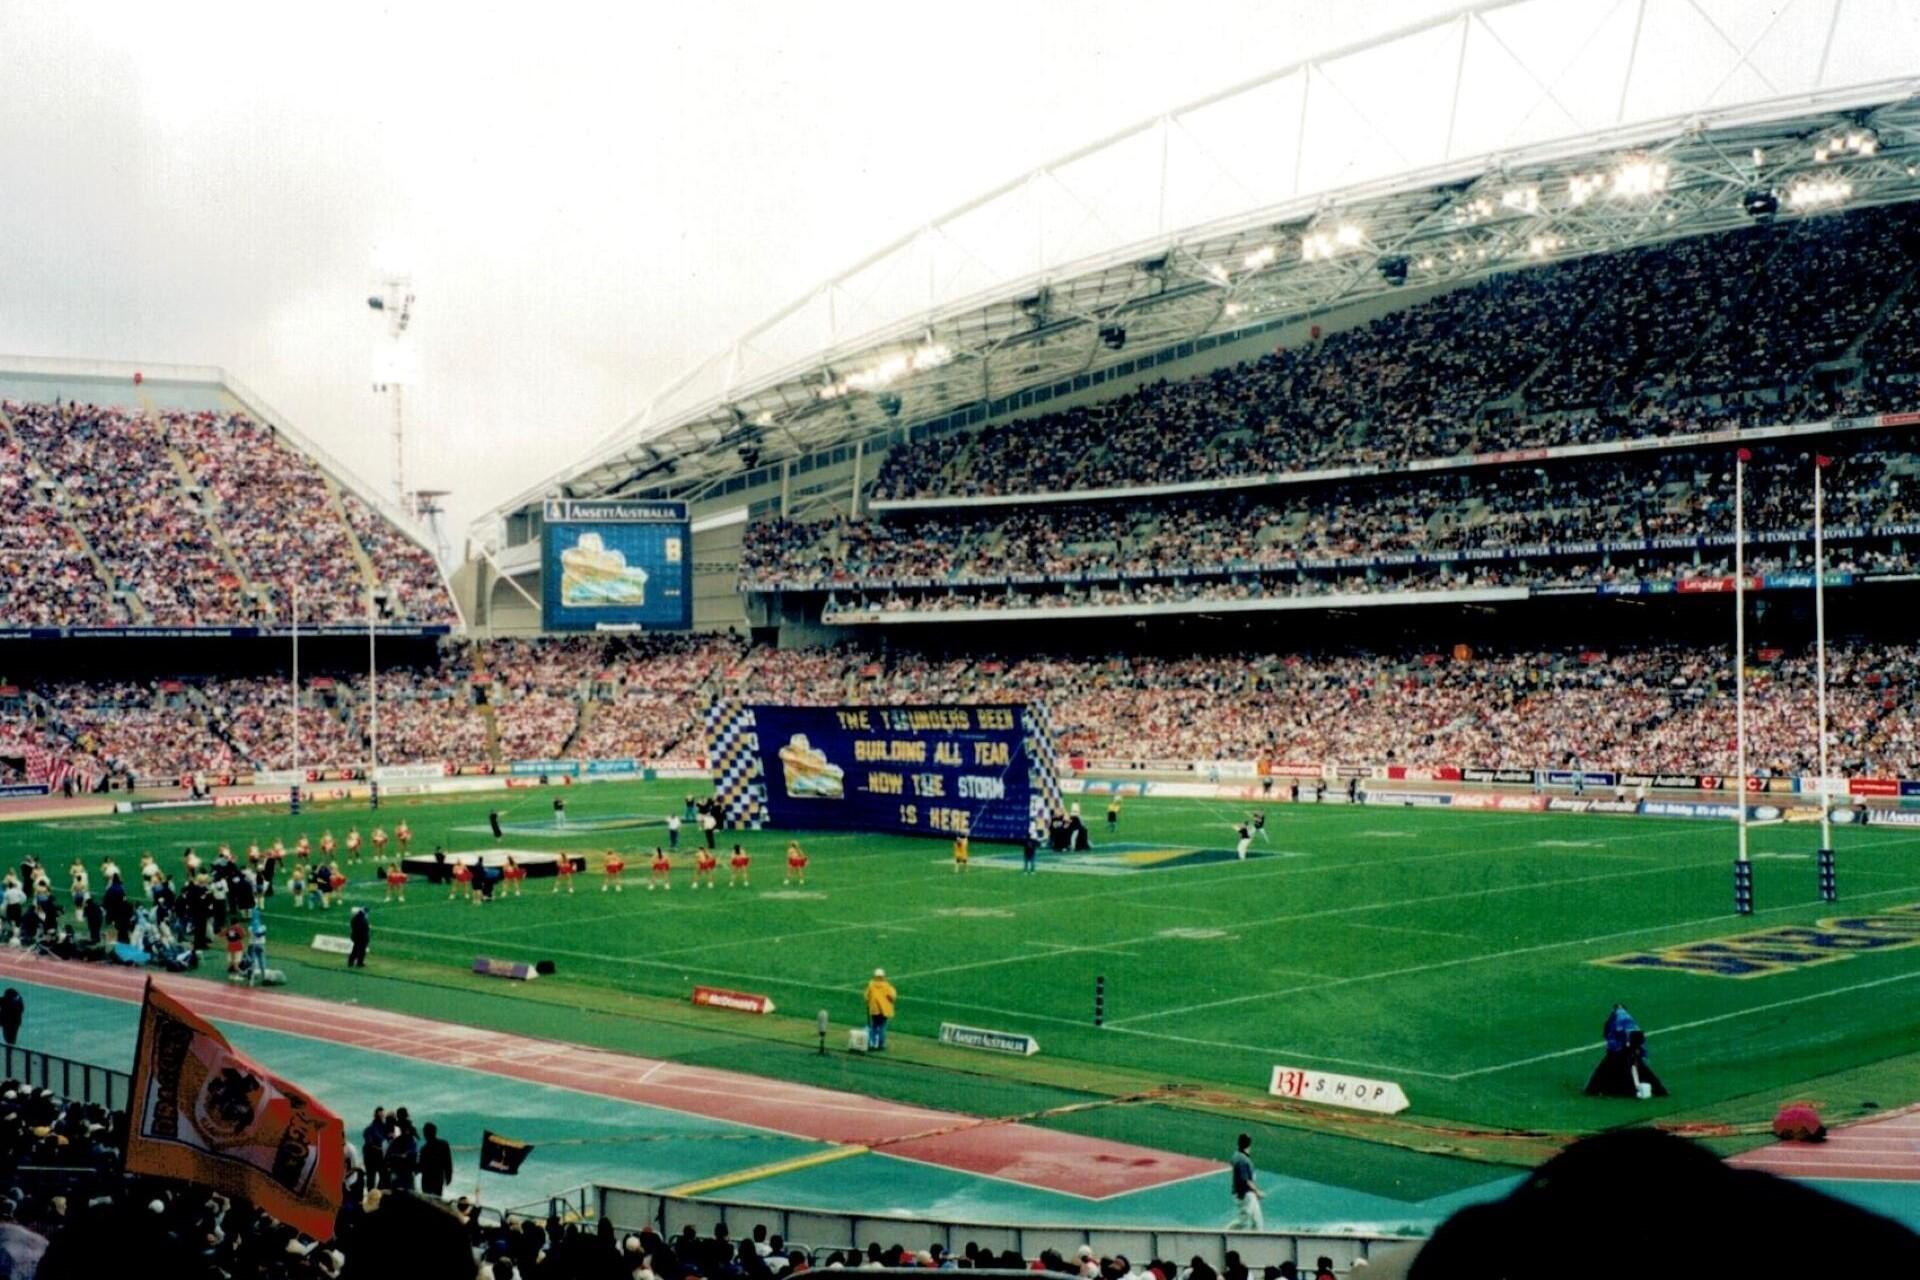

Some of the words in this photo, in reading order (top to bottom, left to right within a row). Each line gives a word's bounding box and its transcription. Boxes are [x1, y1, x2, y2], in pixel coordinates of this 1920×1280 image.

[1611, 540, 1647, 552] TOWER
[1659, 537, 1697, 549] TOWER
[837, 711, 871, 731] THE
[976, 708, 1014, 731] BEEN
[854, 740, 926, 763] BUILDING
[934, 741, 963, 766] ALL
[974, 742, 1010, 766] YEAR
[911, 773, 946, 797] THE
[958, 775, 1006, 800] STORM
[900, 804, 918, 825] IS
[929, 807, 971, 834] HERE
